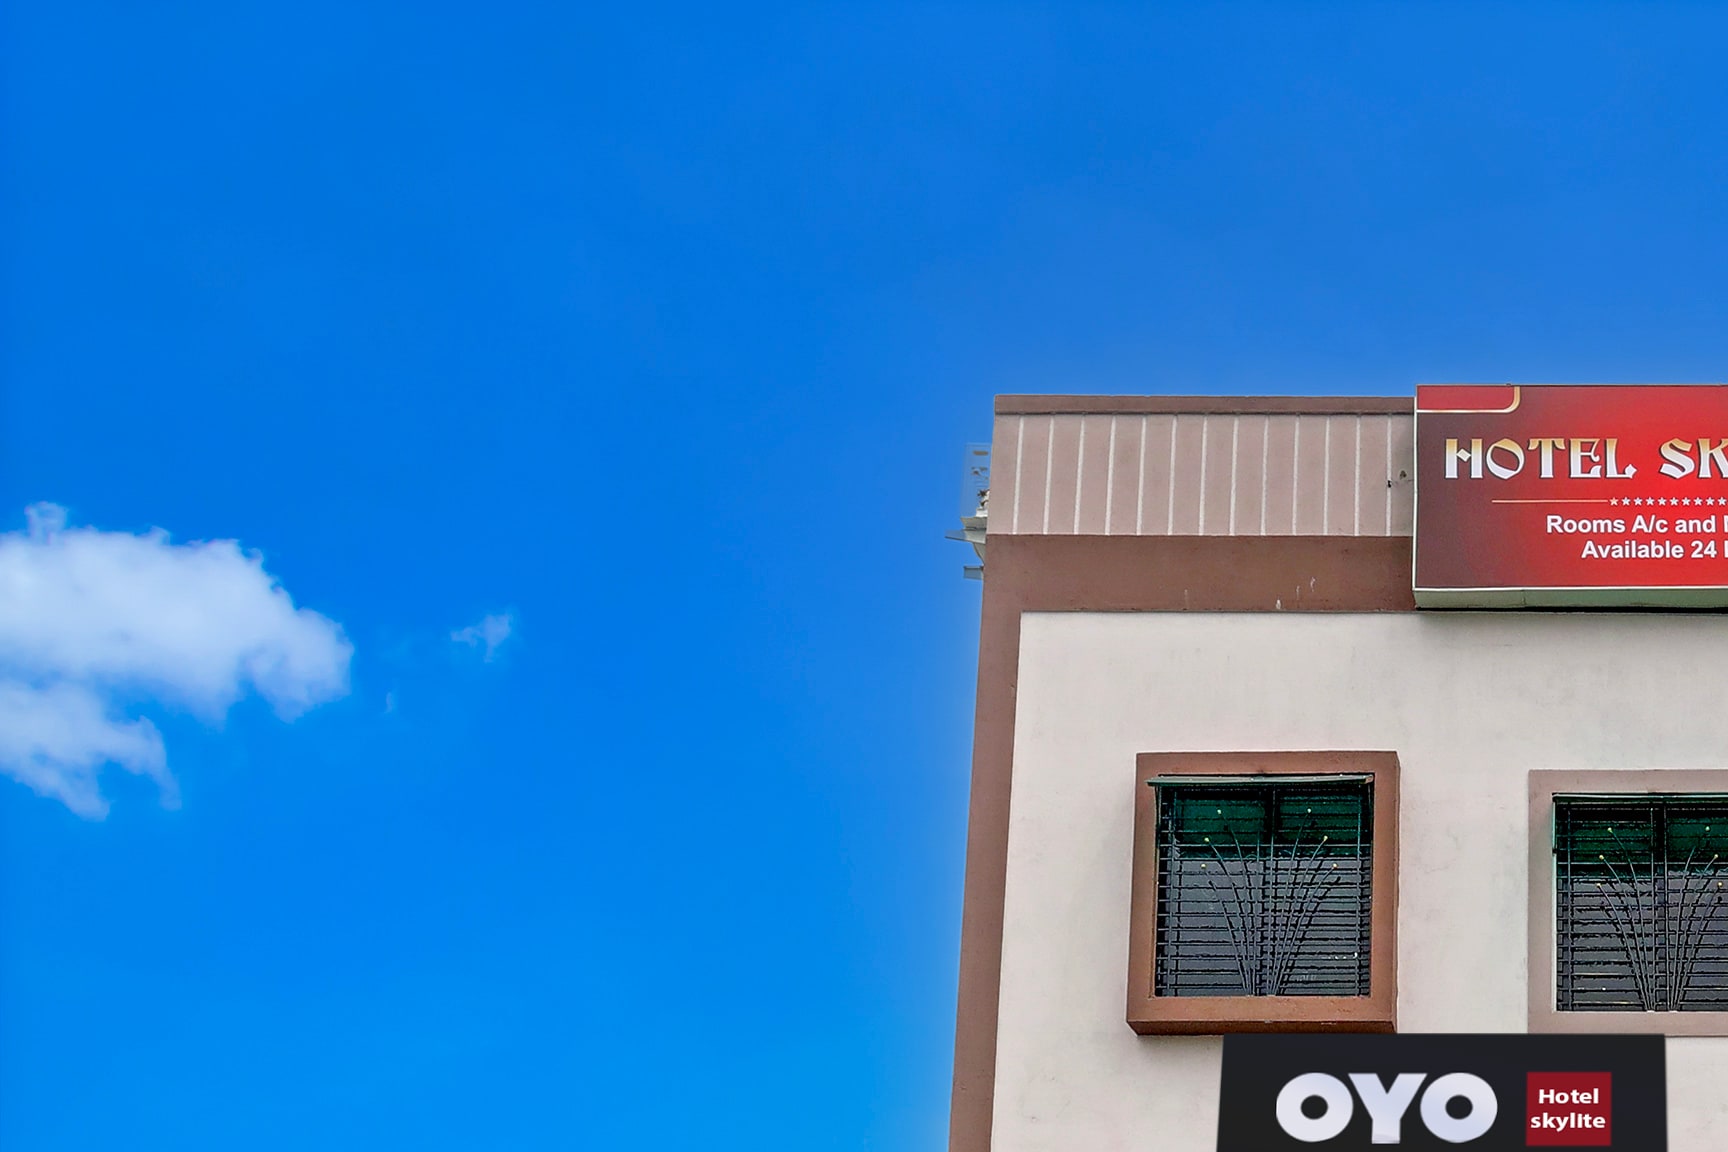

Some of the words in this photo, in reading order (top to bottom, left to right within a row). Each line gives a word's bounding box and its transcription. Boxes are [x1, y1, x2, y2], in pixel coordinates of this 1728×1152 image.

[1443, 437, 1638, 481] HOTEL
[1545, 514, 1626, 535] Rooms
[1631, 514, 1669, 535] A/c
[1674, 514, 1717, 535] and
[1580, 539, 1685, 560] Available
[1690, 540, 1718, 560] 24
[1538, 1088, 1600, 1105] Hotel
[1275, 1072, 1499, 1145] OYO
[1530, 1112, 1606, 1133] skylite
